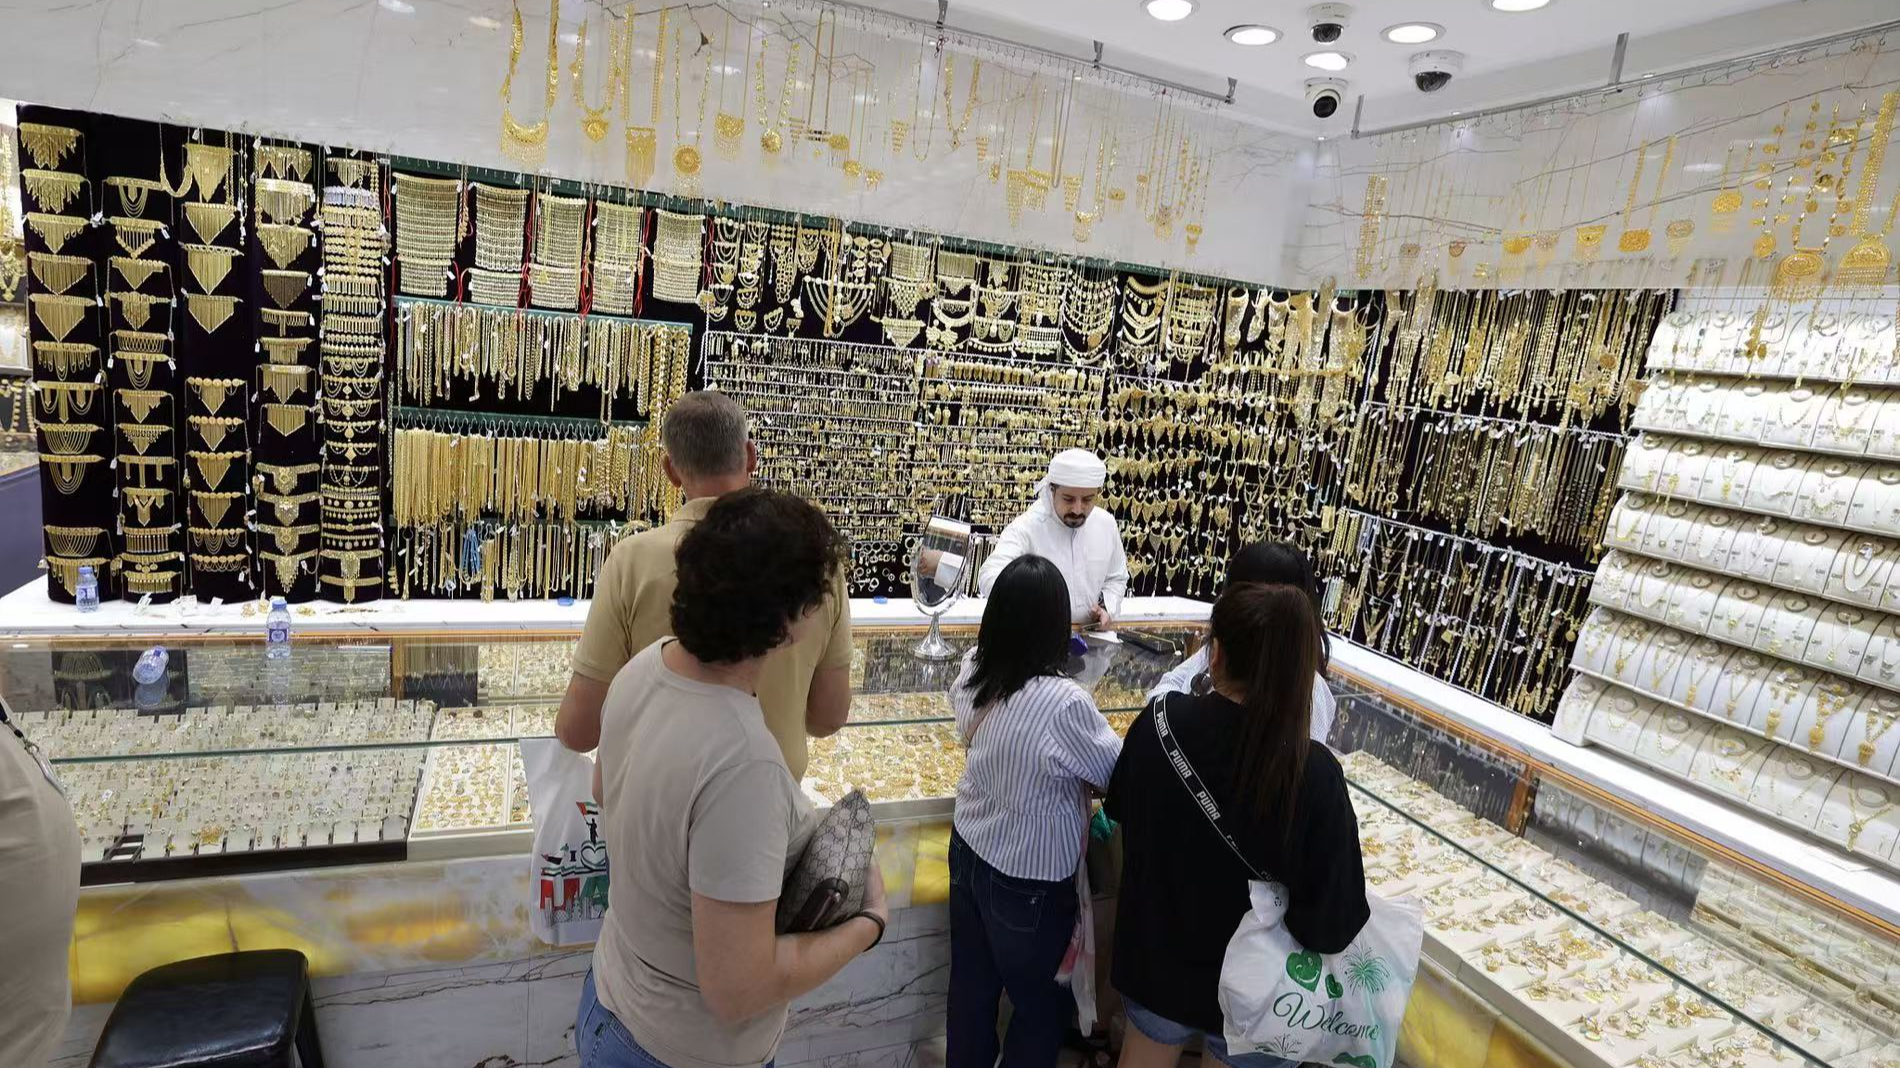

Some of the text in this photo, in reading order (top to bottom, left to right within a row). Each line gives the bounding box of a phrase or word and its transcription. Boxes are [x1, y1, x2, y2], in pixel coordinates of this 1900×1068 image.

[1156, 711, 1169, 738] PUMA
[1169, 748, 1192, 779] PUMA
[1196, 790, 1221, 821] PUMA
[570, 850, 577, 862] I
[539, 876, 610, 914] UA
[1273, 992, 1380, 1041] Welcome
